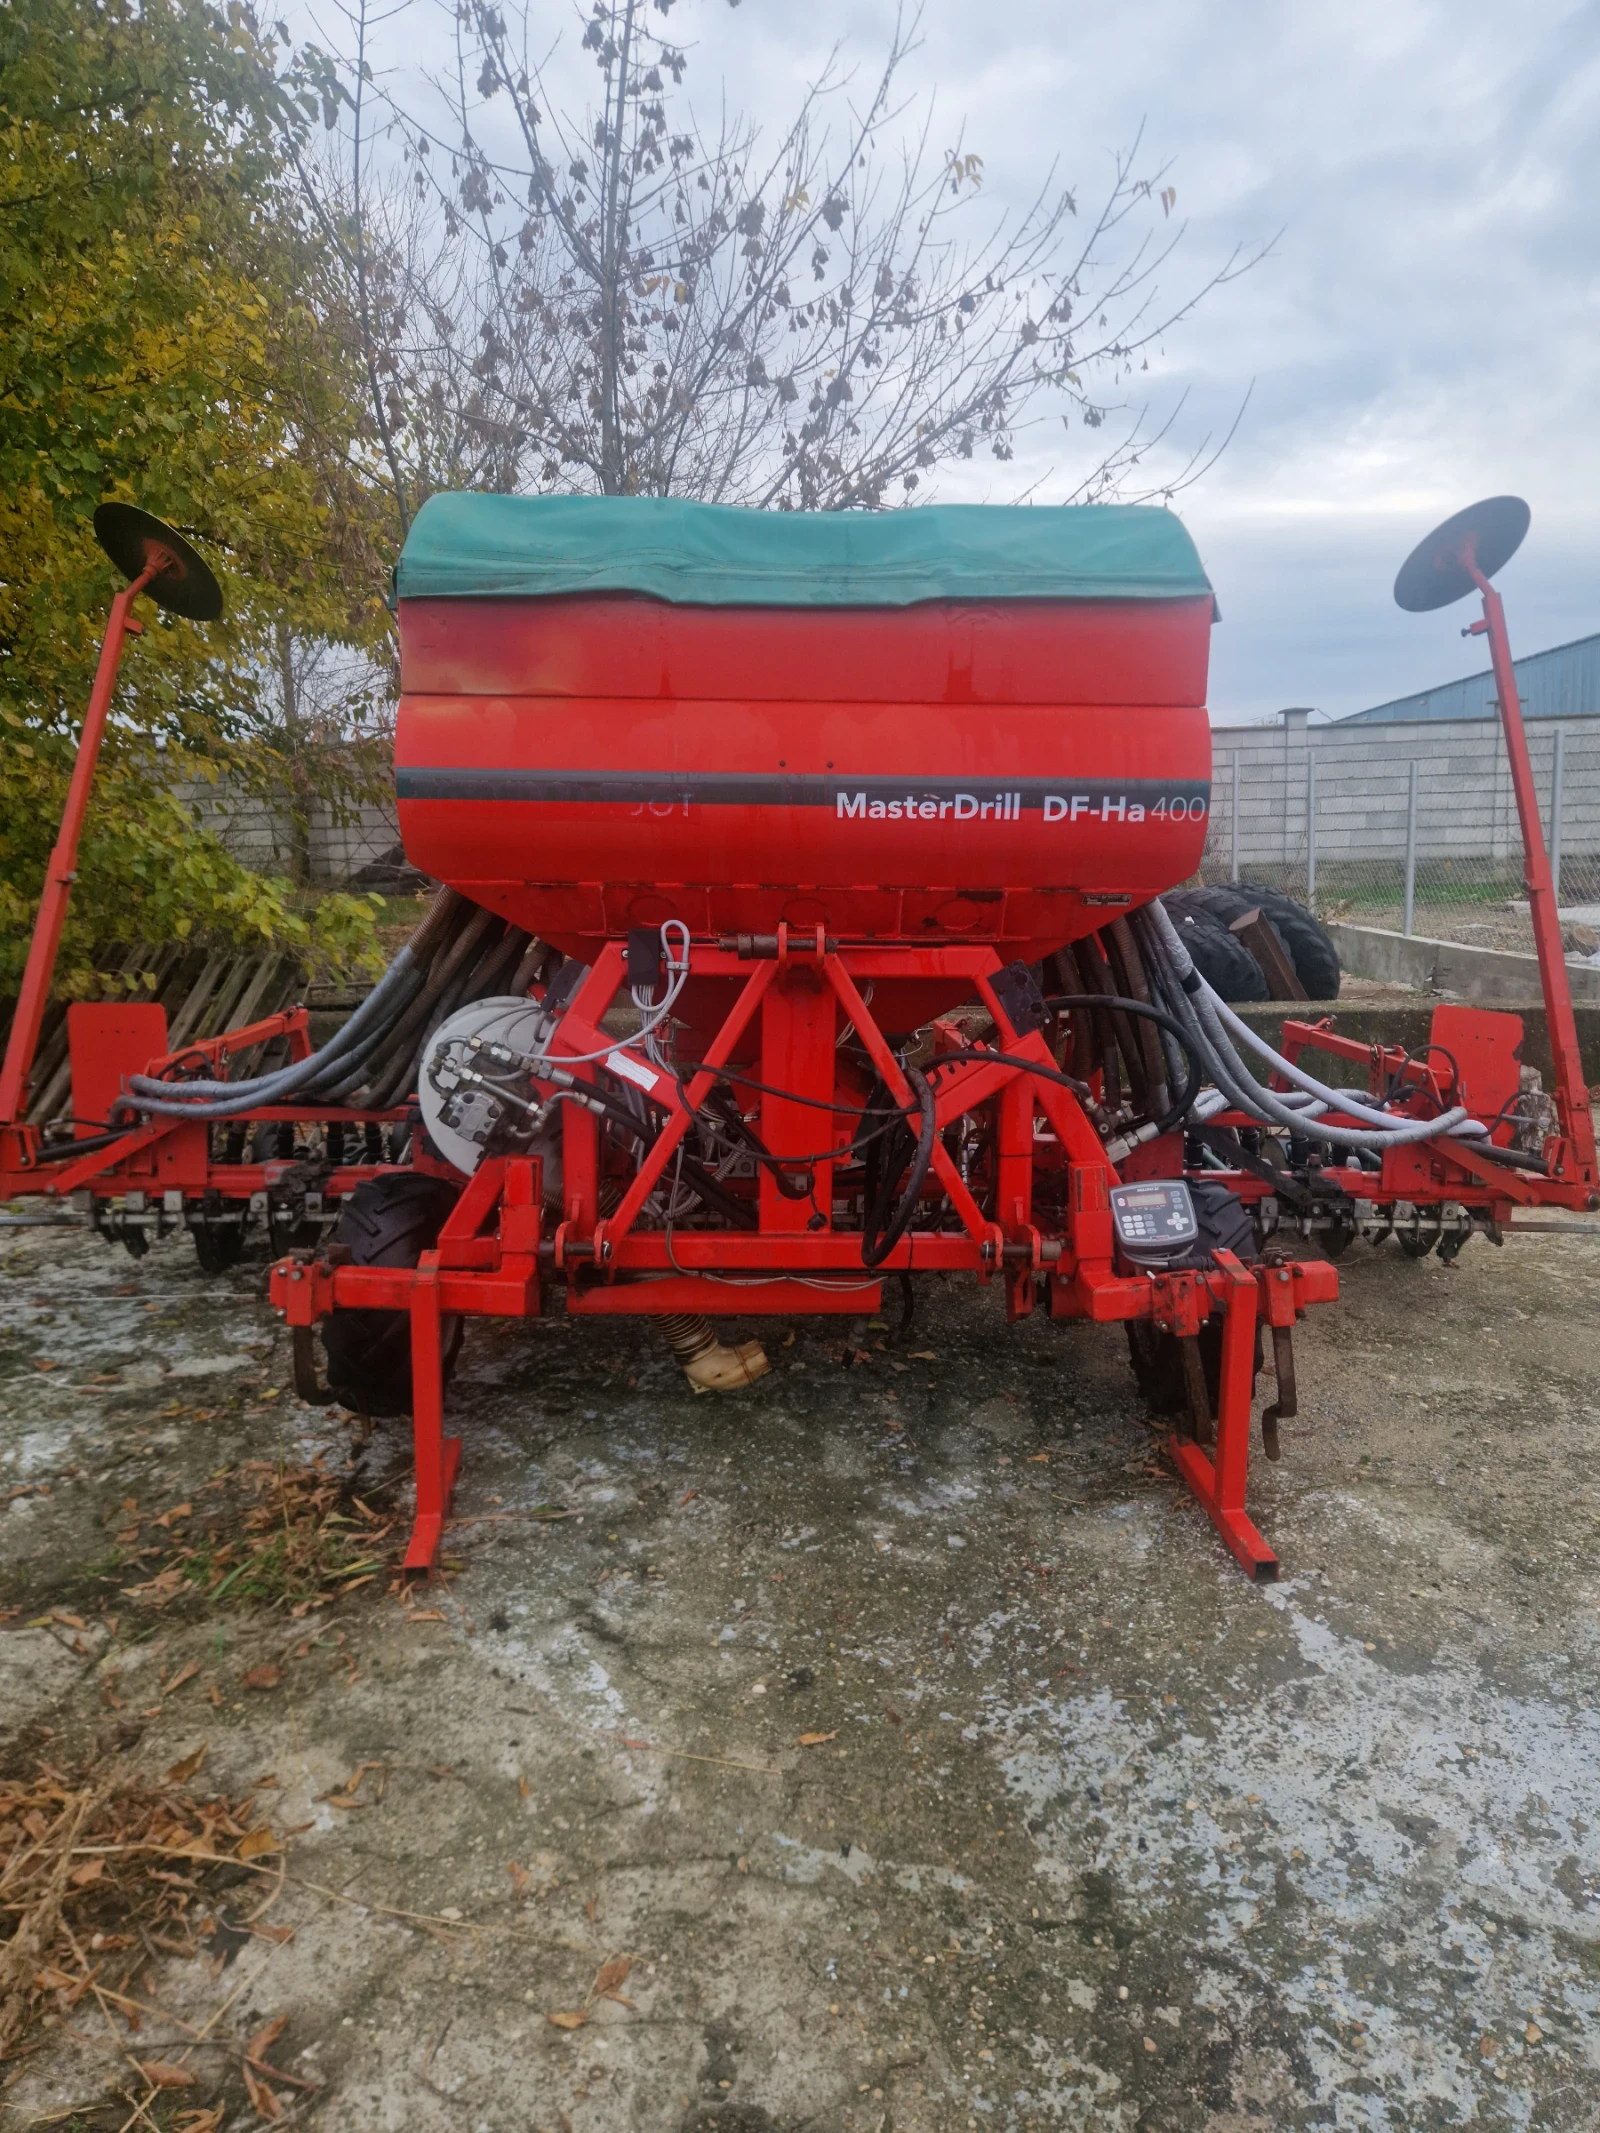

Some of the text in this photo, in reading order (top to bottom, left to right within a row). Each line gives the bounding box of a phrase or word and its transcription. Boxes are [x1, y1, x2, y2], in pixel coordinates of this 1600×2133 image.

[836, 792, 1206, 822] MasterDrill DF-Ha 400
